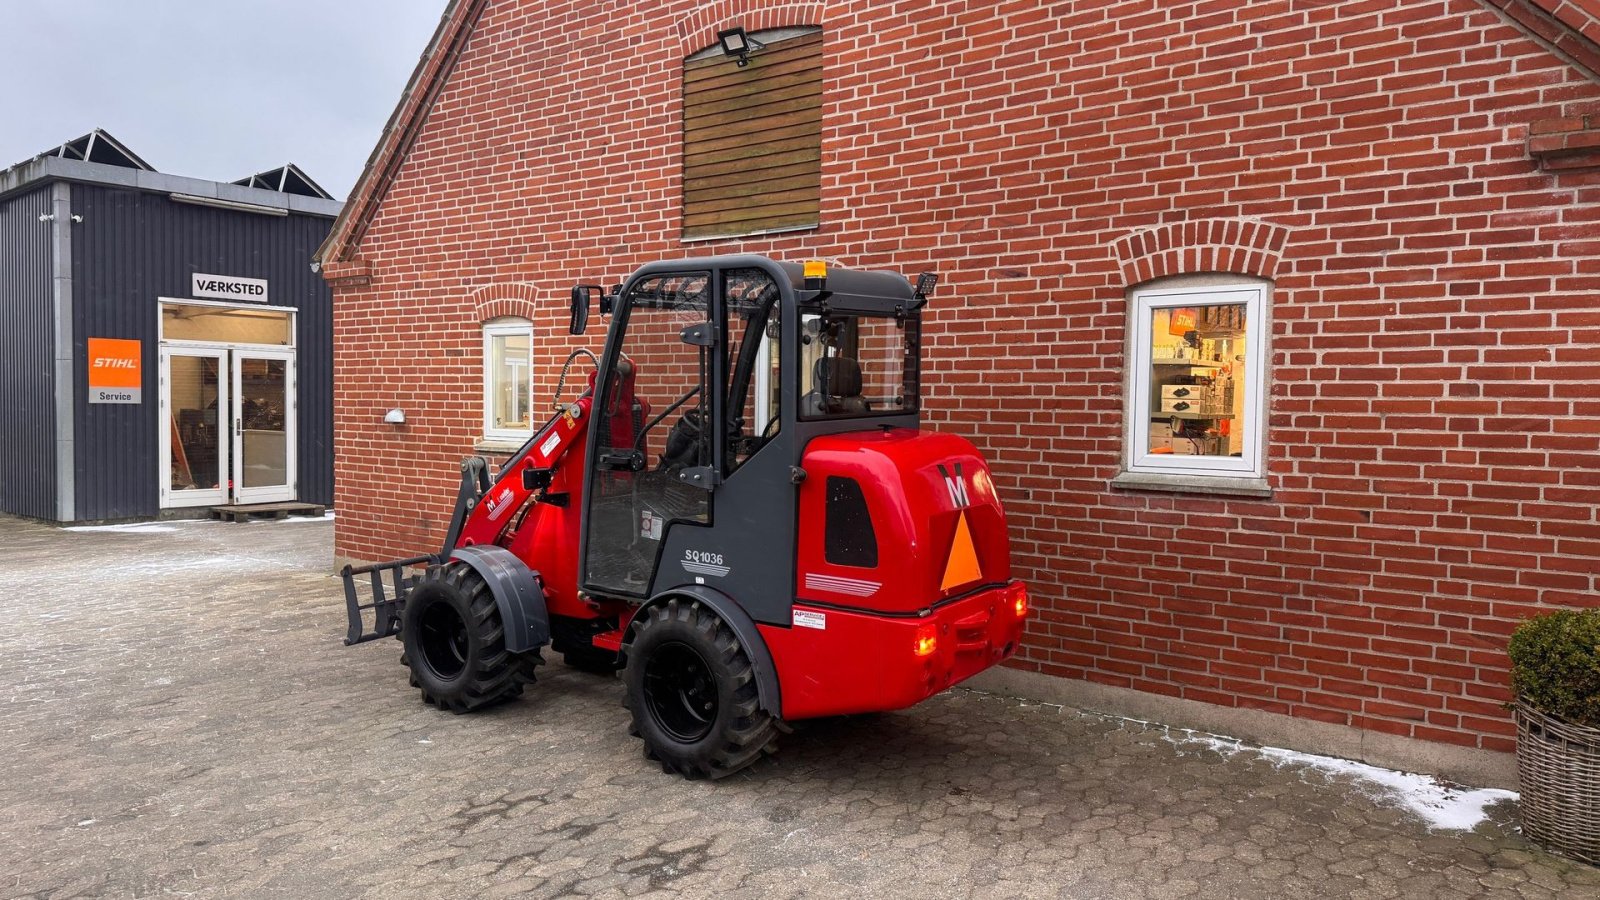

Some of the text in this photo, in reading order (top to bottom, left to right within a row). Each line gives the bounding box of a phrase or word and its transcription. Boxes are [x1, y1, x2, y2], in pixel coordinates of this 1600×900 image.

[196, 279, 264, 295] VÆRKSTED
[93, 357, 136, 369] STIHL
[99, 391, 132, 401] Service
[685, 549, 723, 565] SQ1036
